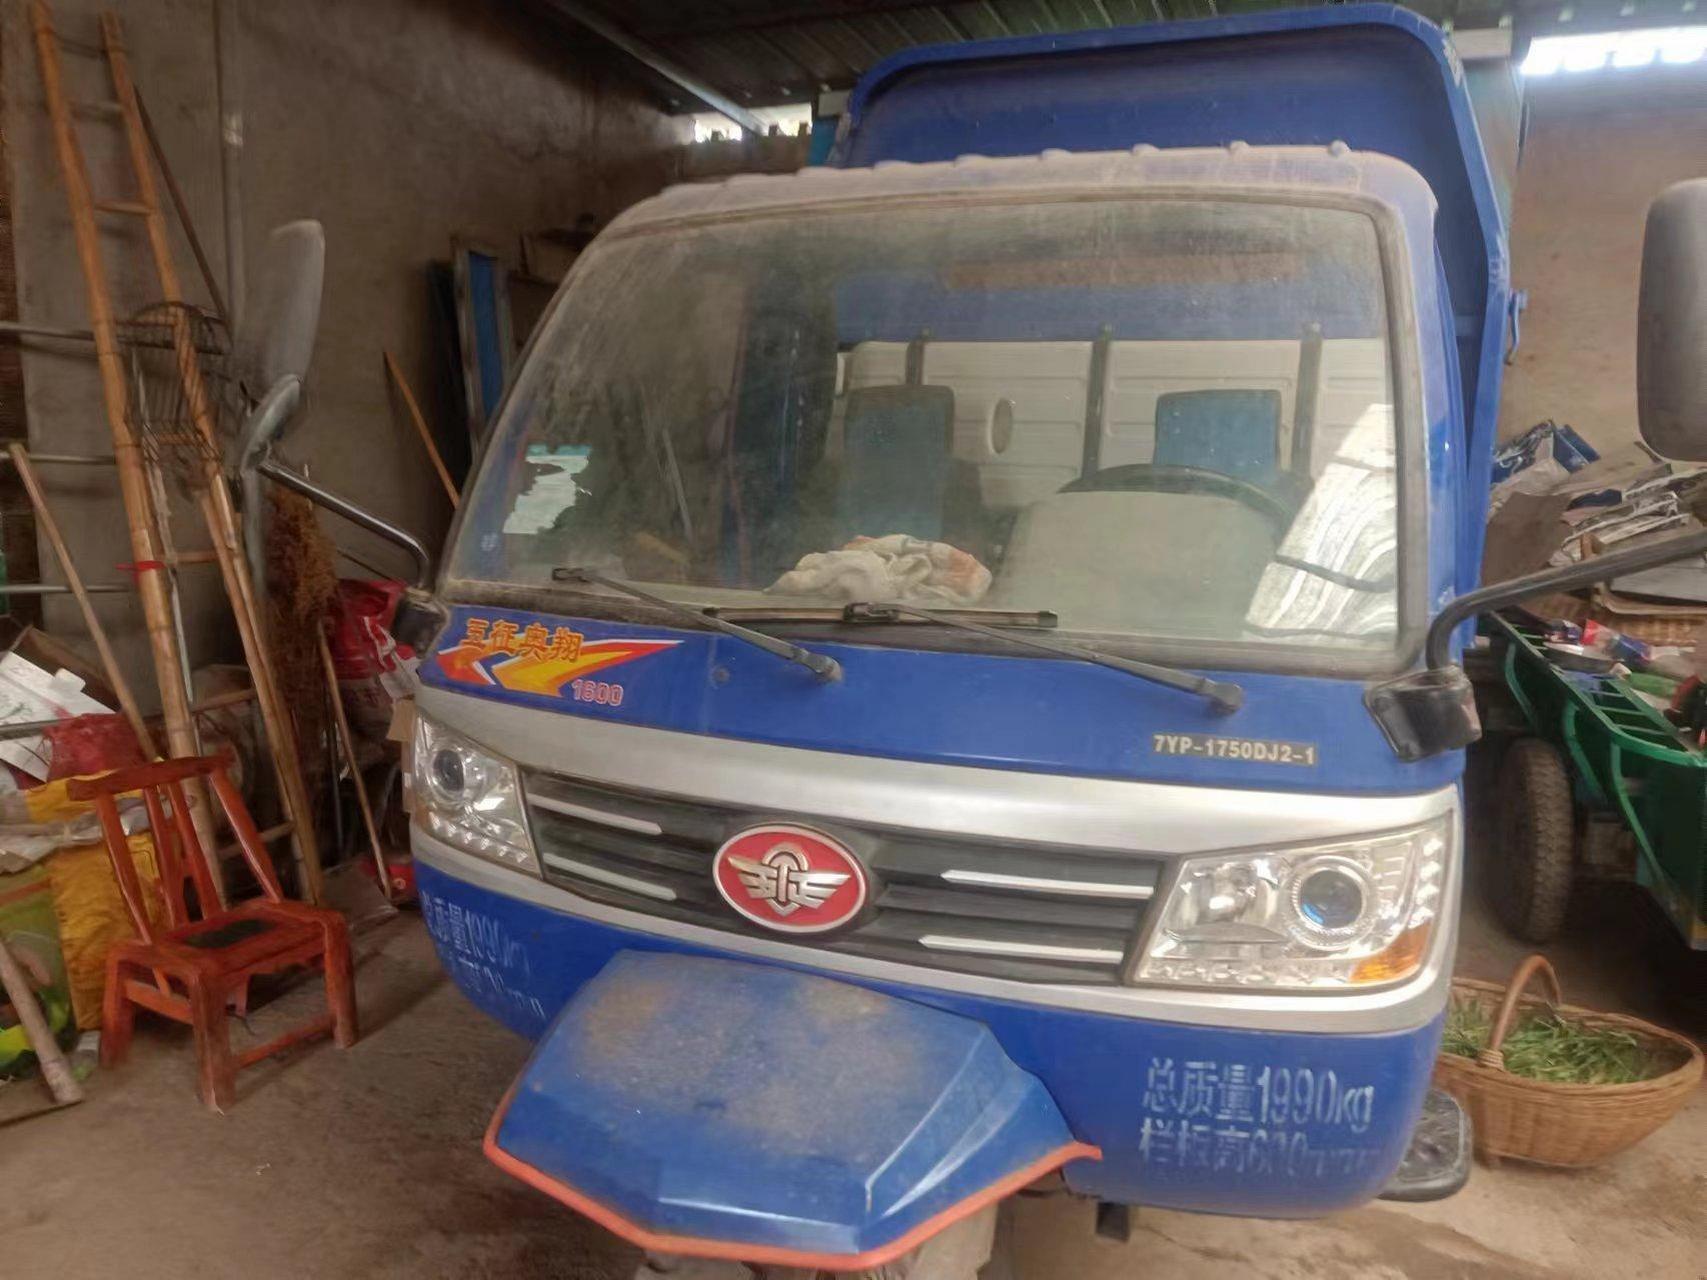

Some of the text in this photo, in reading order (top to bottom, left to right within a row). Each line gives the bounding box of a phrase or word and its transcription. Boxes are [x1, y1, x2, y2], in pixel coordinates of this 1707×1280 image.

[460, 618, 584, 662] 五征奥翔
[571, 679, 624, 706] 1600
[1153, 734, 1315, 765] 7YP-1750DJ2-1
[1142, 1057, 1375, 1133] 总质量1990kg
